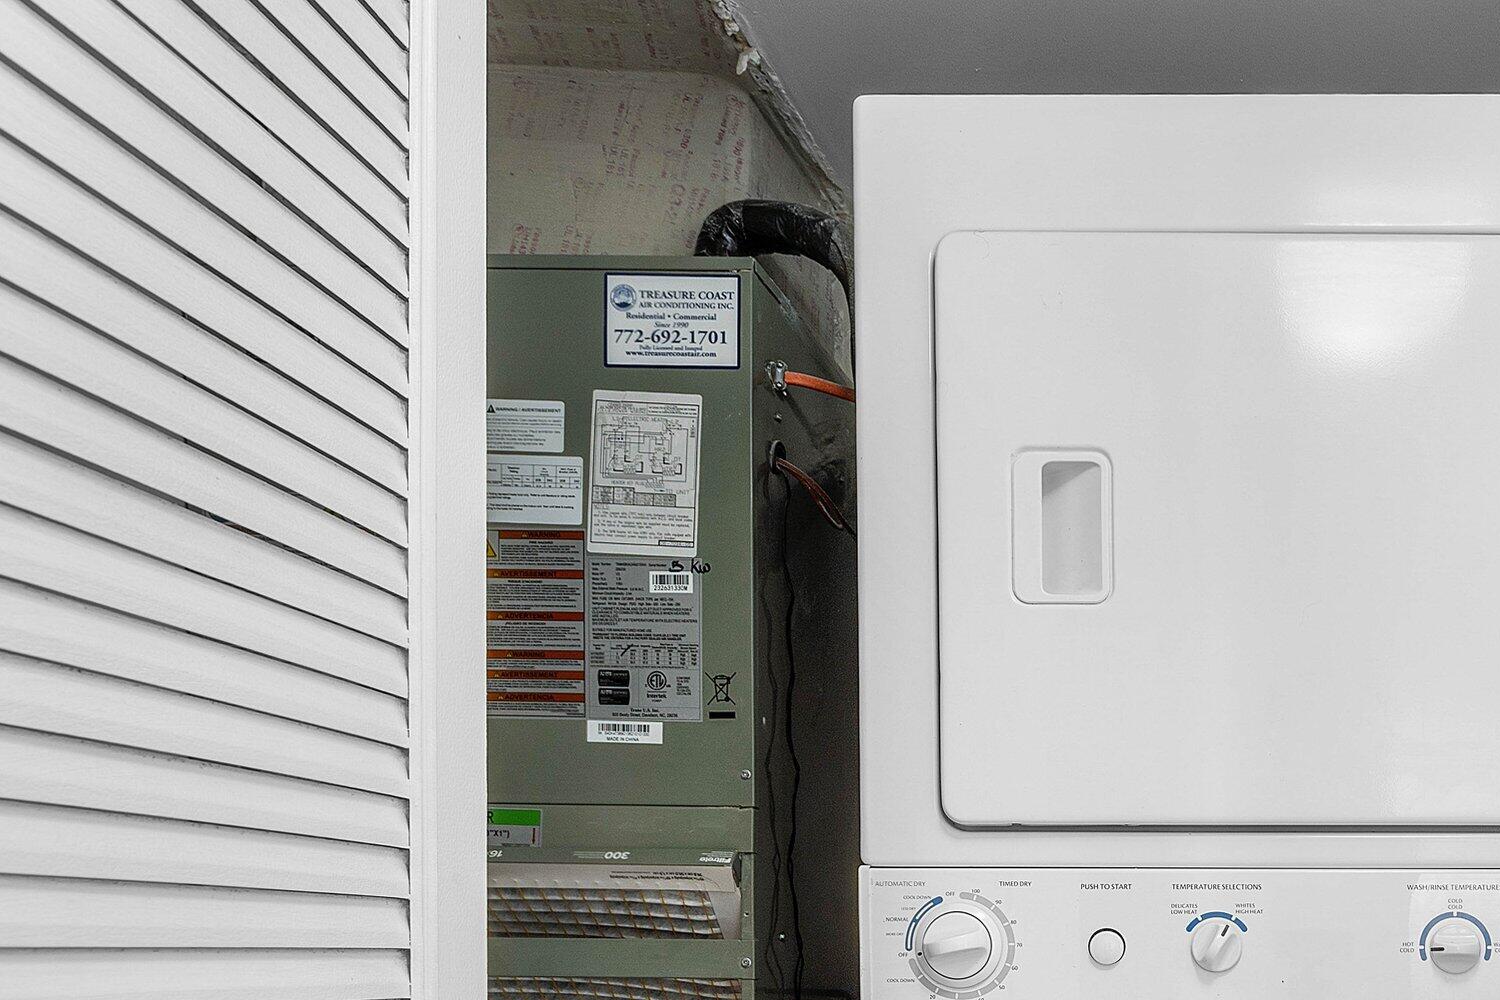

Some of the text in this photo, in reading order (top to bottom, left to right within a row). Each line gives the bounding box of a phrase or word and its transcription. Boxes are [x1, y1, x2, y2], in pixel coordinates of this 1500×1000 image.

[640, 290, 735, 300] TREASURE COAST
[626, 312, 666, 320] Residential
[614, 329, 728, 344] 772-692-1701
[625, 350, 717, 358] www.treasurecoastair.com
[604, 851, 630, 860] 300
